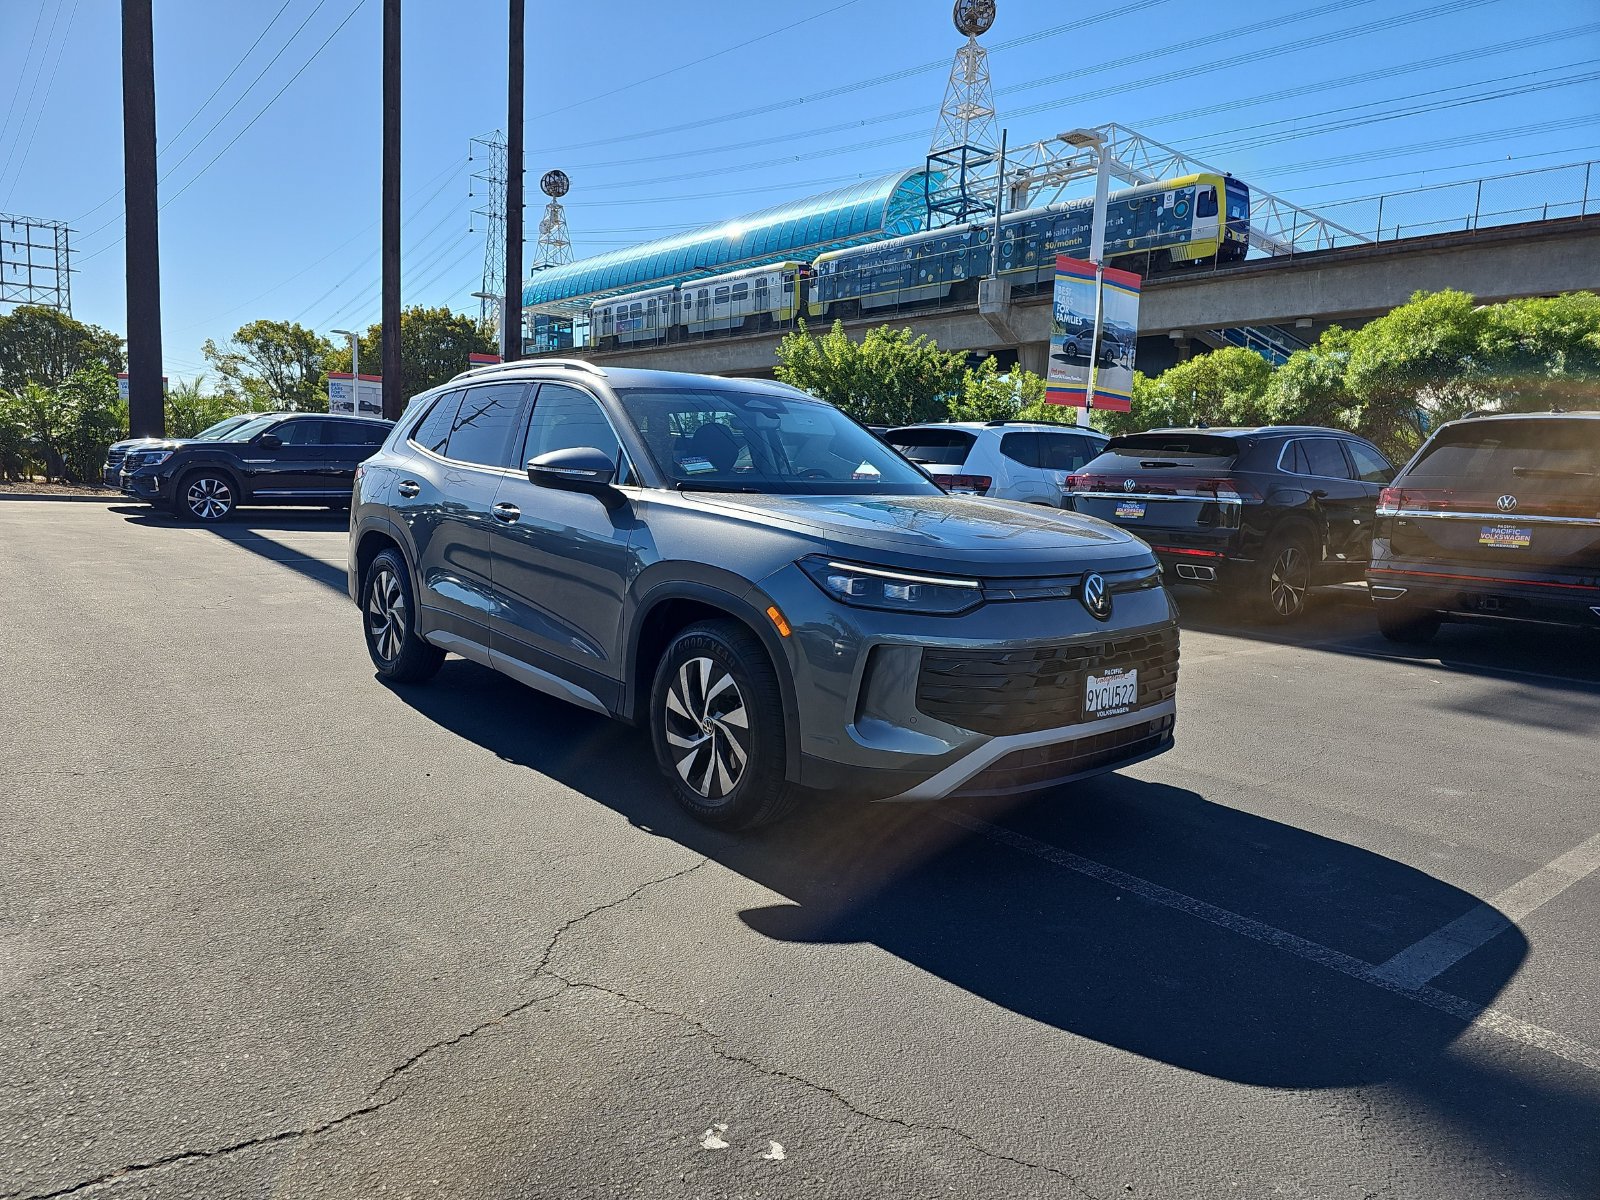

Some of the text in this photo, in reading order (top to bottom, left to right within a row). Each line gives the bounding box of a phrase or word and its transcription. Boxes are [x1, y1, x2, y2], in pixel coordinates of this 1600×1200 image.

[1071, 223, 1089, 236] plan
[1057, 285, 1073, 297] BEST
[1056, 303, 1071, 315] FOR
[1056, 312, 1083, 326] FAMILIES
[1480, 532, 1531, 542] VOLKSWAGEN
[1104, 667, 1123, 676] PACIFIC
[1087, 683, 1135, 712] 9YCU522
[1097, 706, 1130, 718] VOLKSWAGEN
